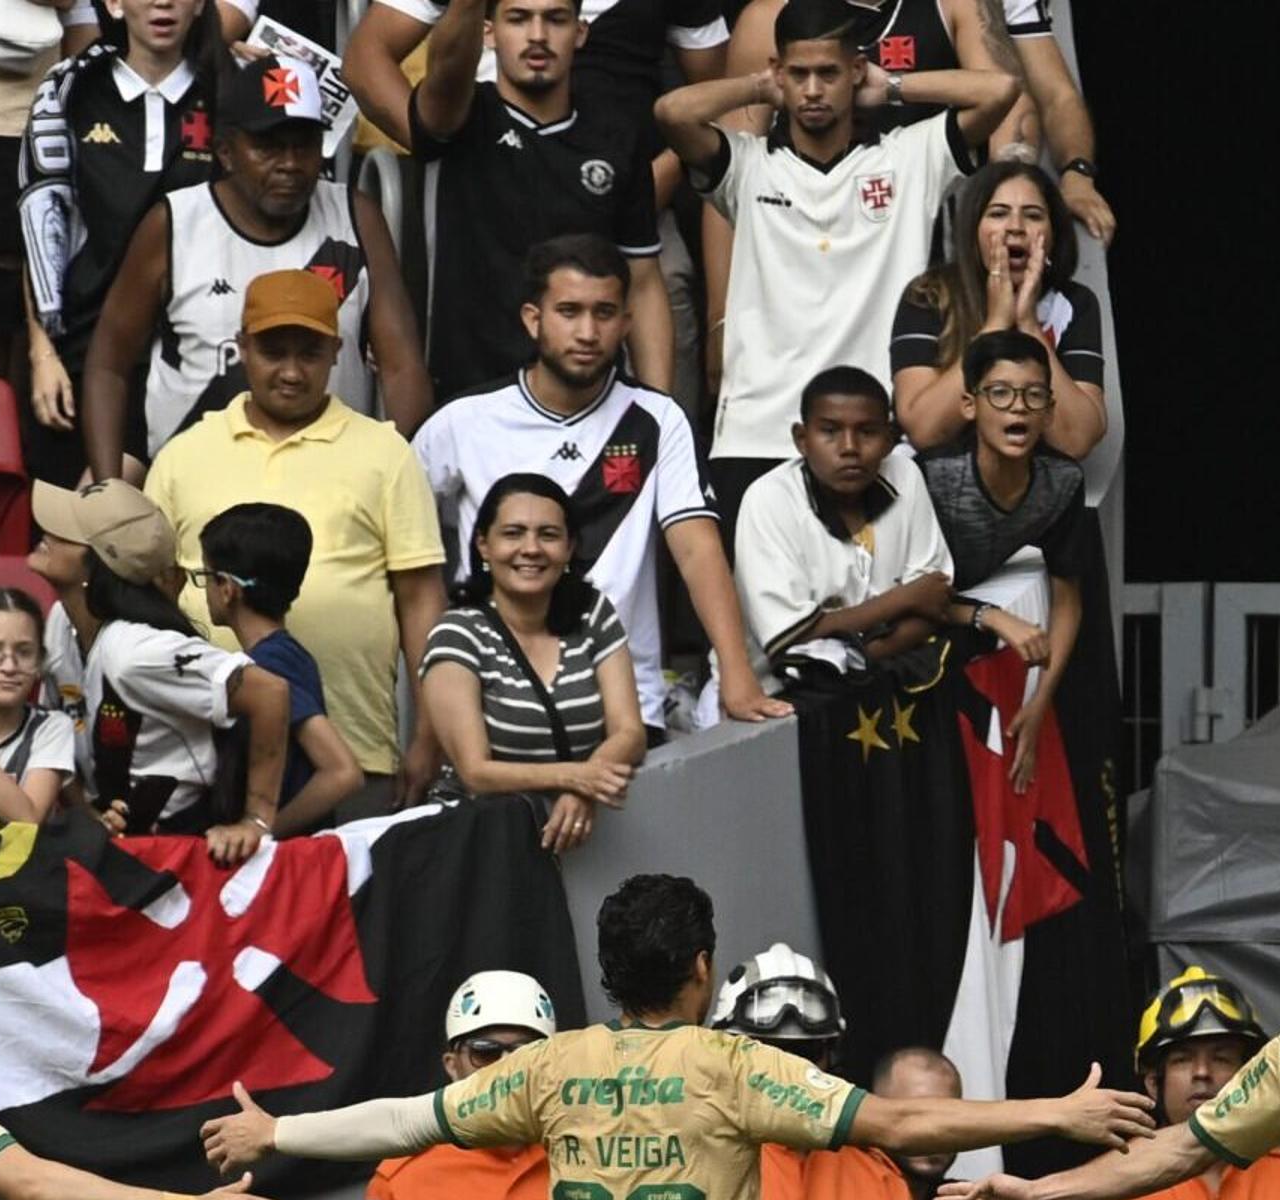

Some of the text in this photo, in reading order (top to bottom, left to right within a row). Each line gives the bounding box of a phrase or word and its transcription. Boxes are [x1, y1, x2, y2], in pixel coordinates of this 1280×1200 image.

[561, 1067, 685, 1116] crefisa
[748, 1072, 825, 1119] crefisa
[1216, 1056, 1269, 1118] crefisa
[565, 1135, 685, 1168] R. VEIGA
